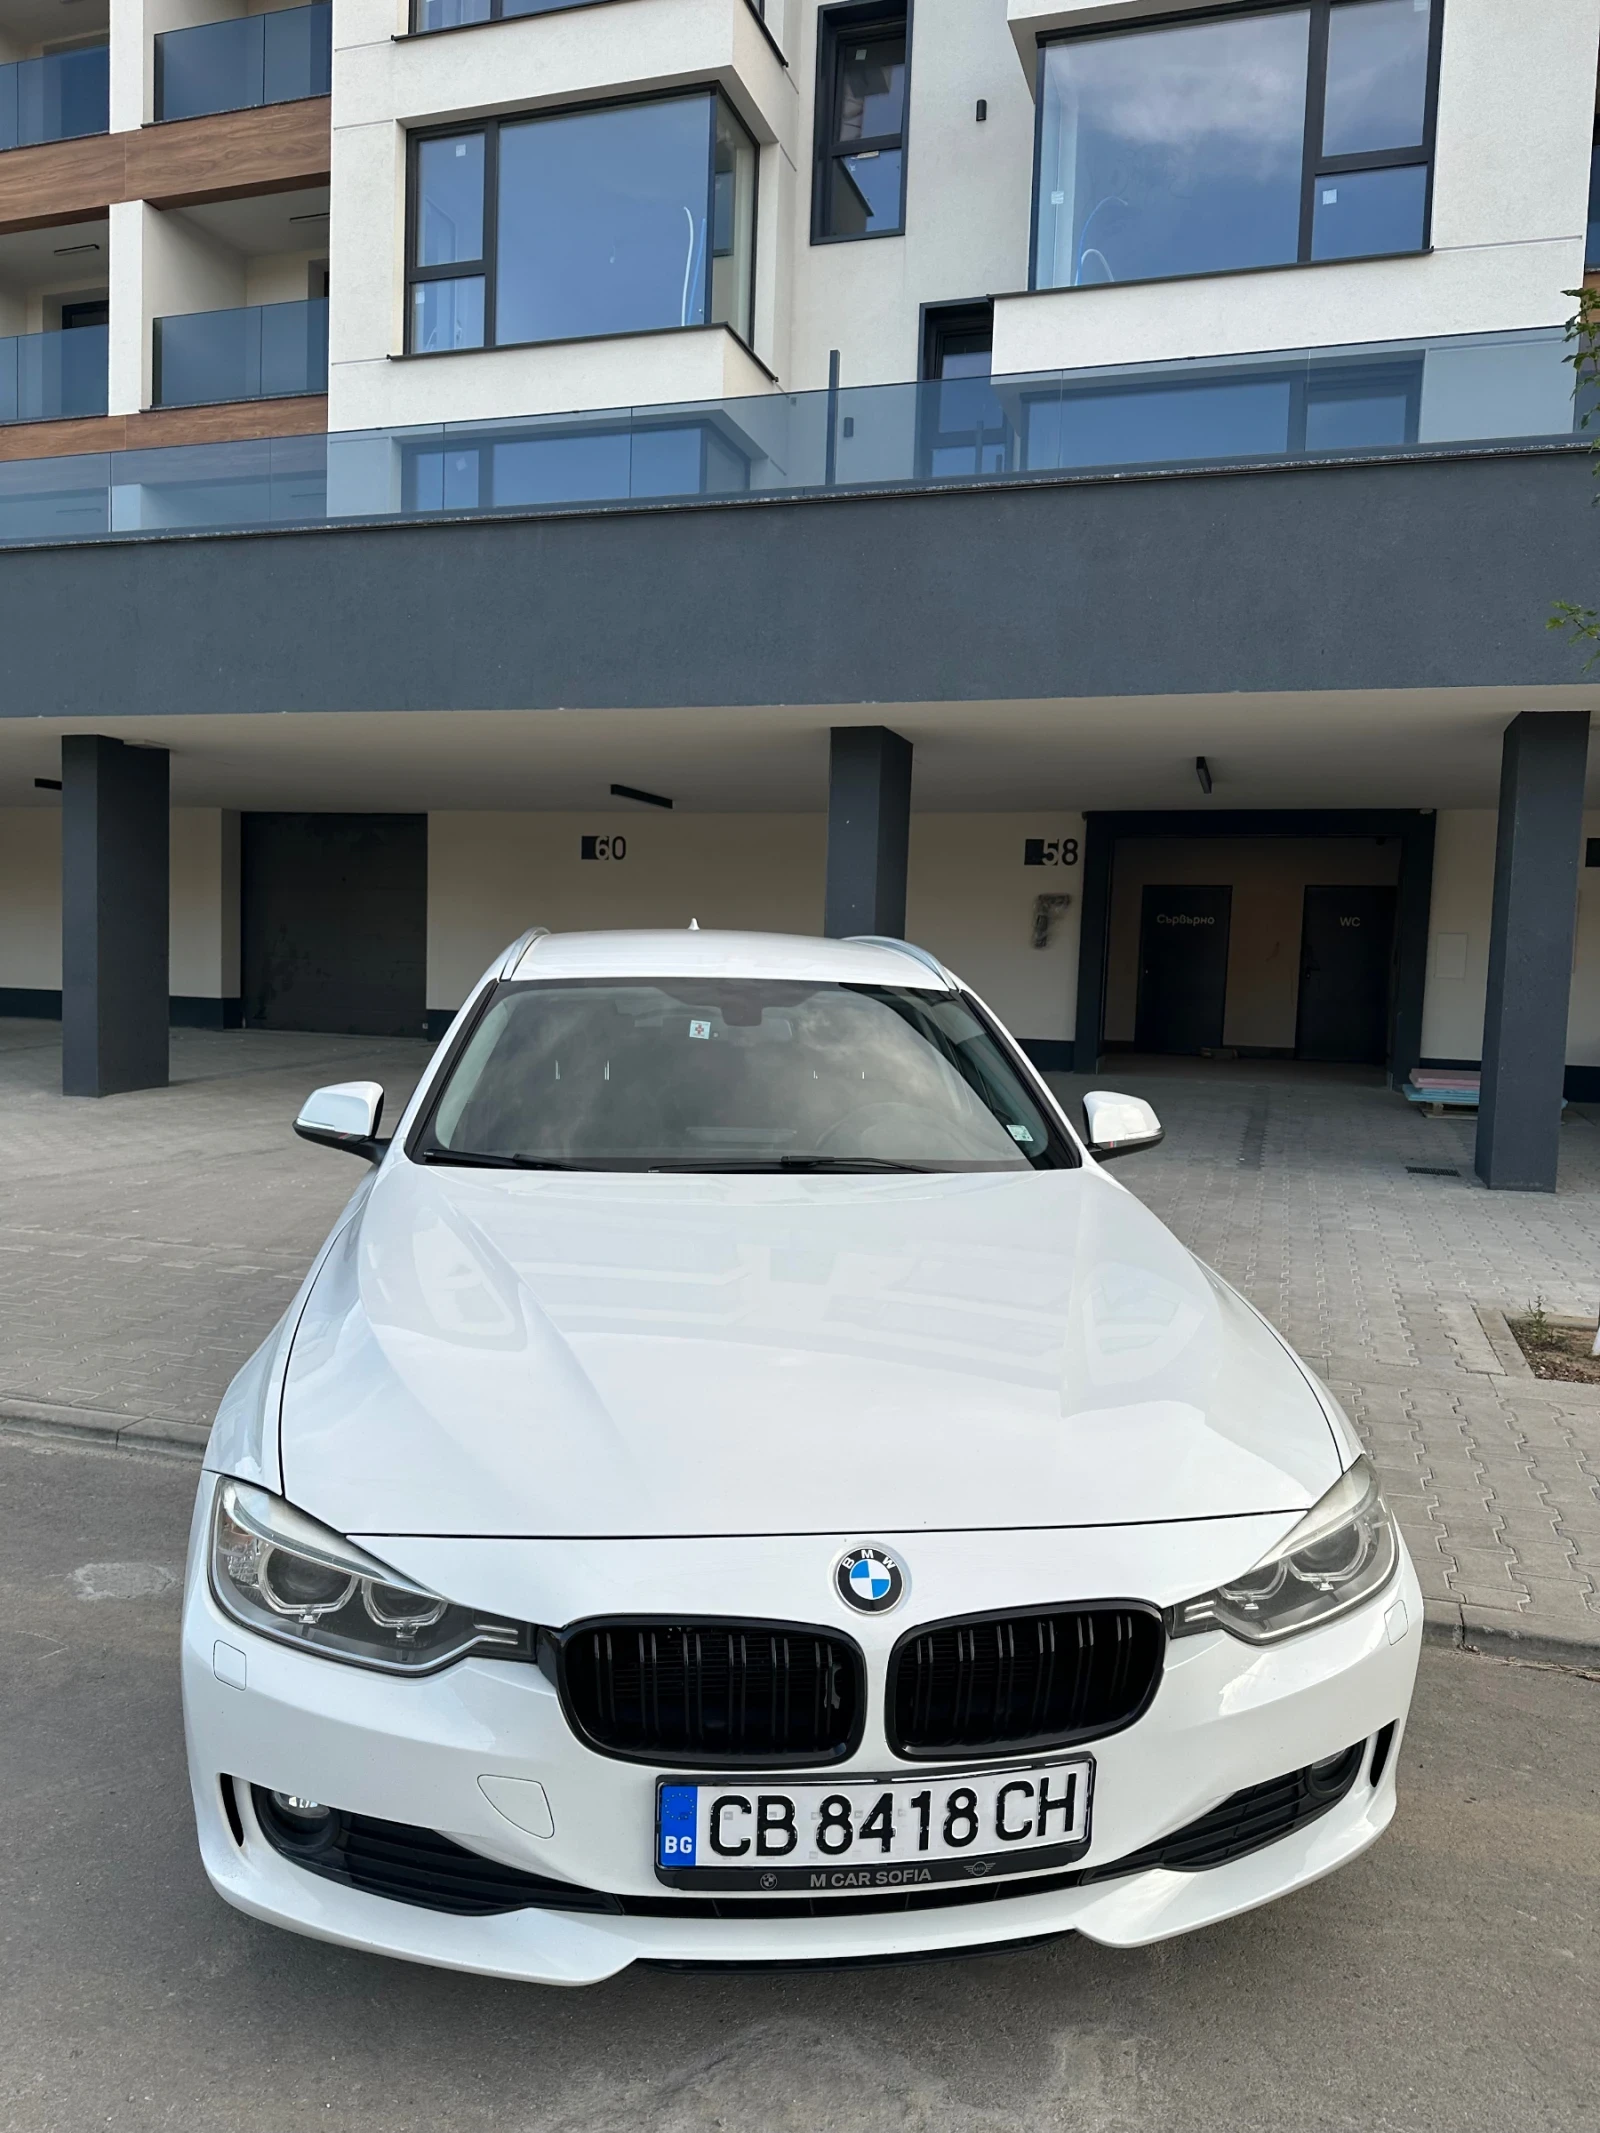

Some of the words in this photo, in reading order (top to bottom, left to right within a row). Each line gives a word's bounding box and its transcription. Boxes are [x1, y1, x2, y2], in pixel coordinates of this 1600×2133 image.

[594, 836, 626, 860] 60
[1041, 838, 1078, 866] 58
[1156, 913, 1216, 927] Сървърно
[1339, 916, 1361, 927] WC
[842, 1549, 896, 1570] BMW
[709, 1794, 798, 1858] CB
[815, 1787, 979, 1856] 8418
[995, 1773, 1078, 1842] CH
[665, 1835, 693, 1855] BG
[810, 1873, 828, 1888] M
[831, 1872, 871, 1887] CAR
[875, 1868, 932, 1886] SOFIA
